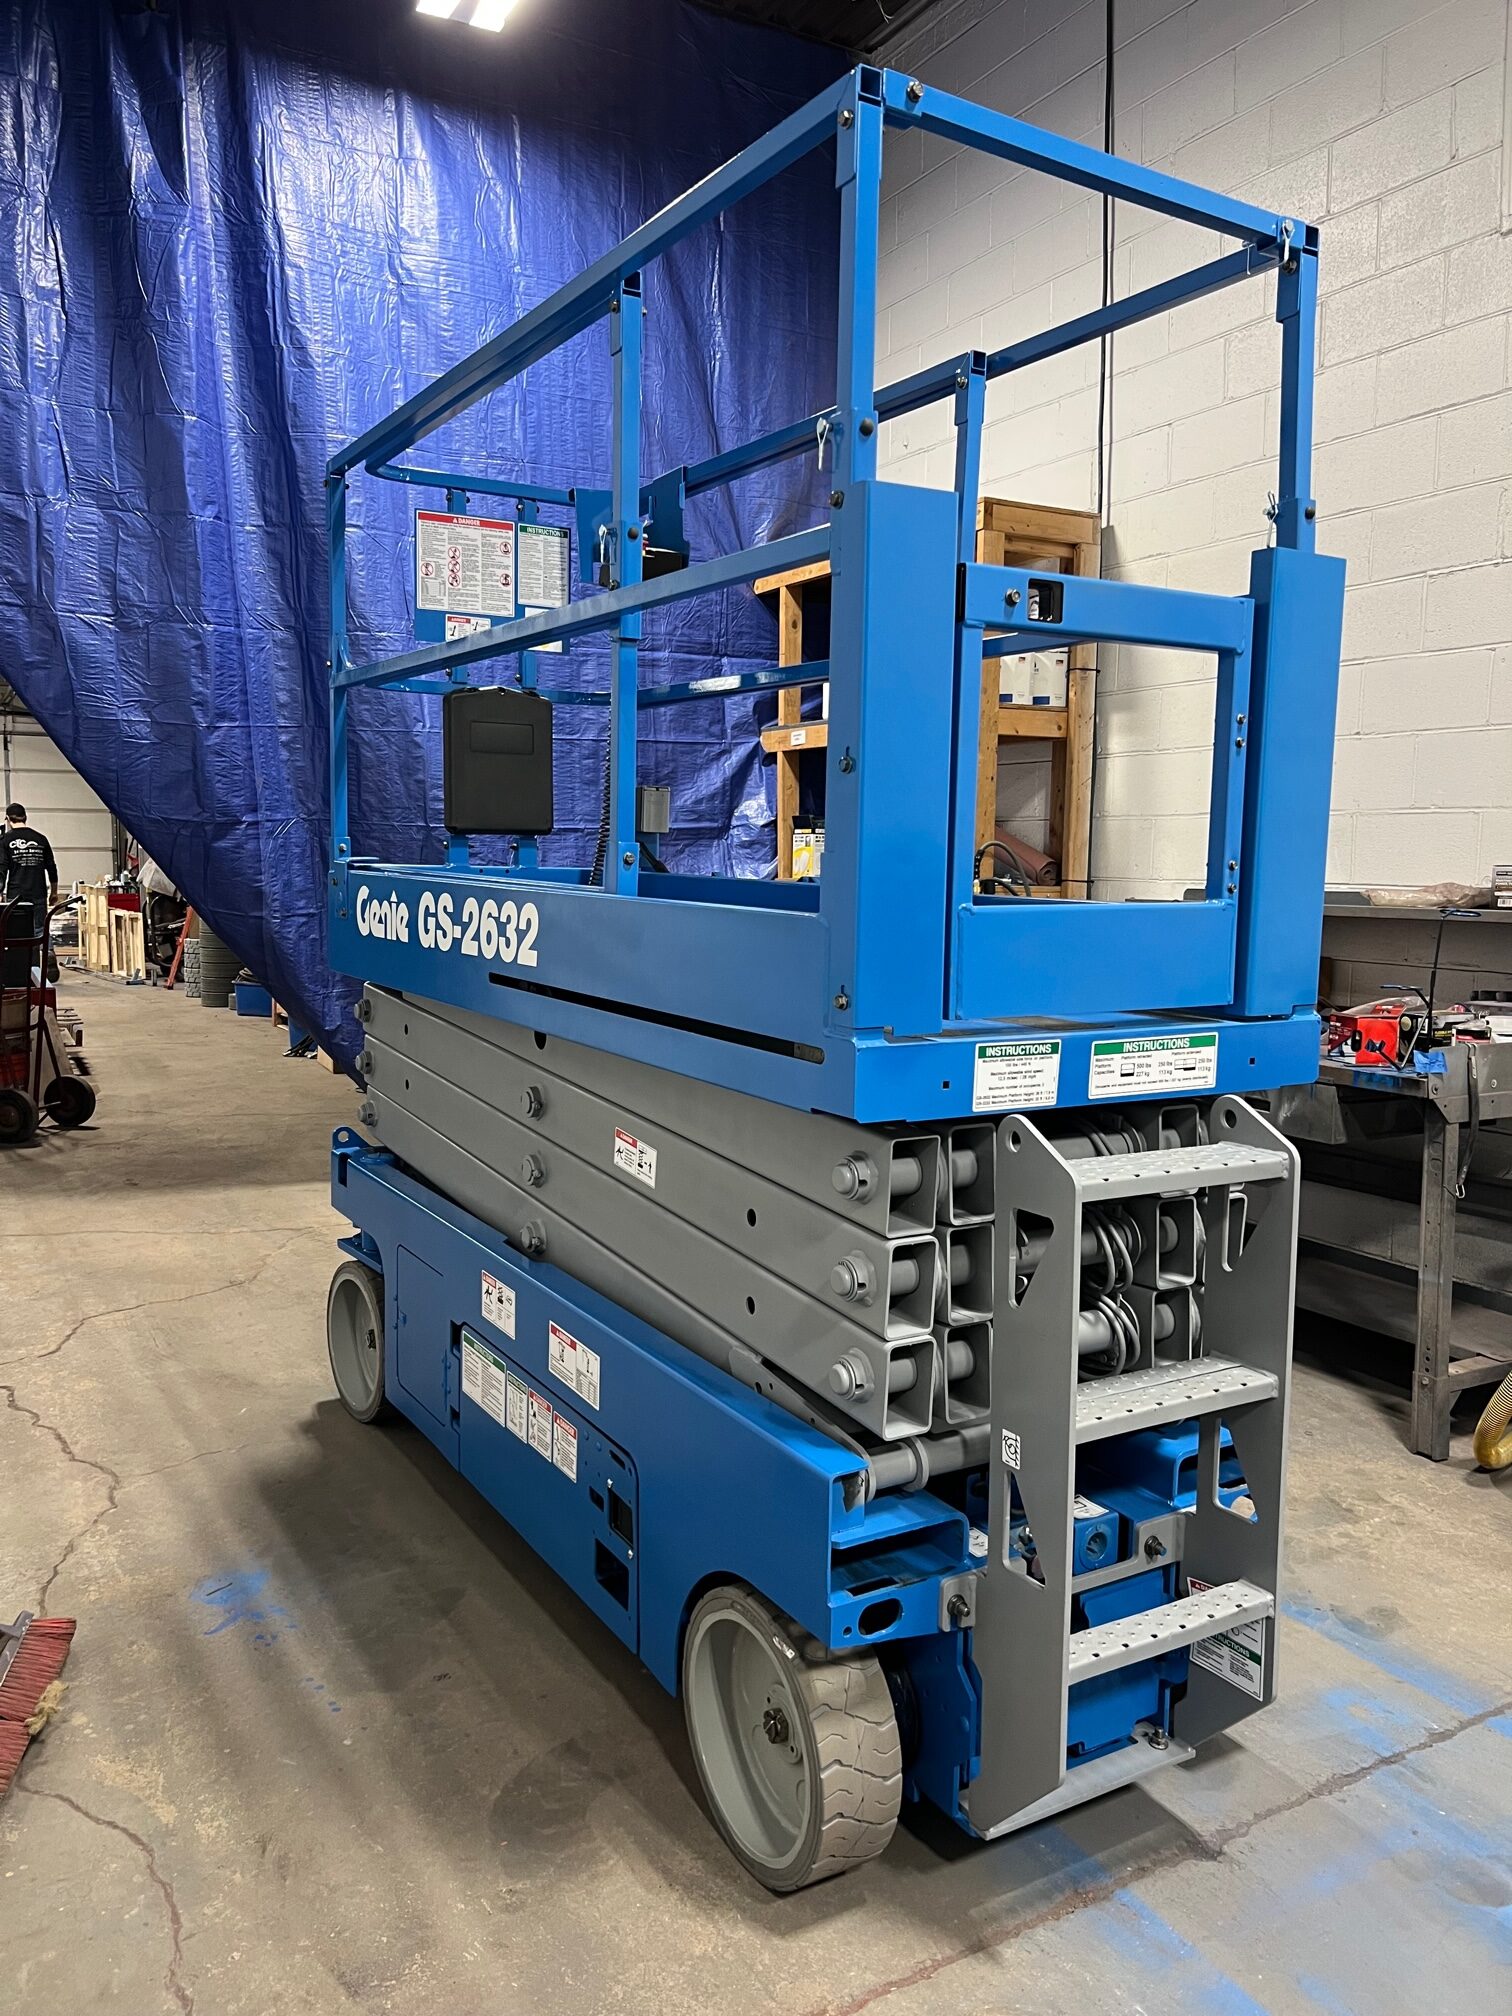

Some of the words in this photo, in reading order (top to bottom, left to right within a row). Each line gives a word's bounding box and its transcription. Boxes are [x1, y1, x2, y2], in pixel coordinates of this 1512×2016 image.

[458, 518, 480, 526] DANGER
[356, 885, 409, 943] Genie
[418, 891, 539, 968] GS-2632
[985, 1044, 1052, 1057] INSTRUCTIONS
[1122, 1038, 1190, 1053] INSTRUCTIONS
